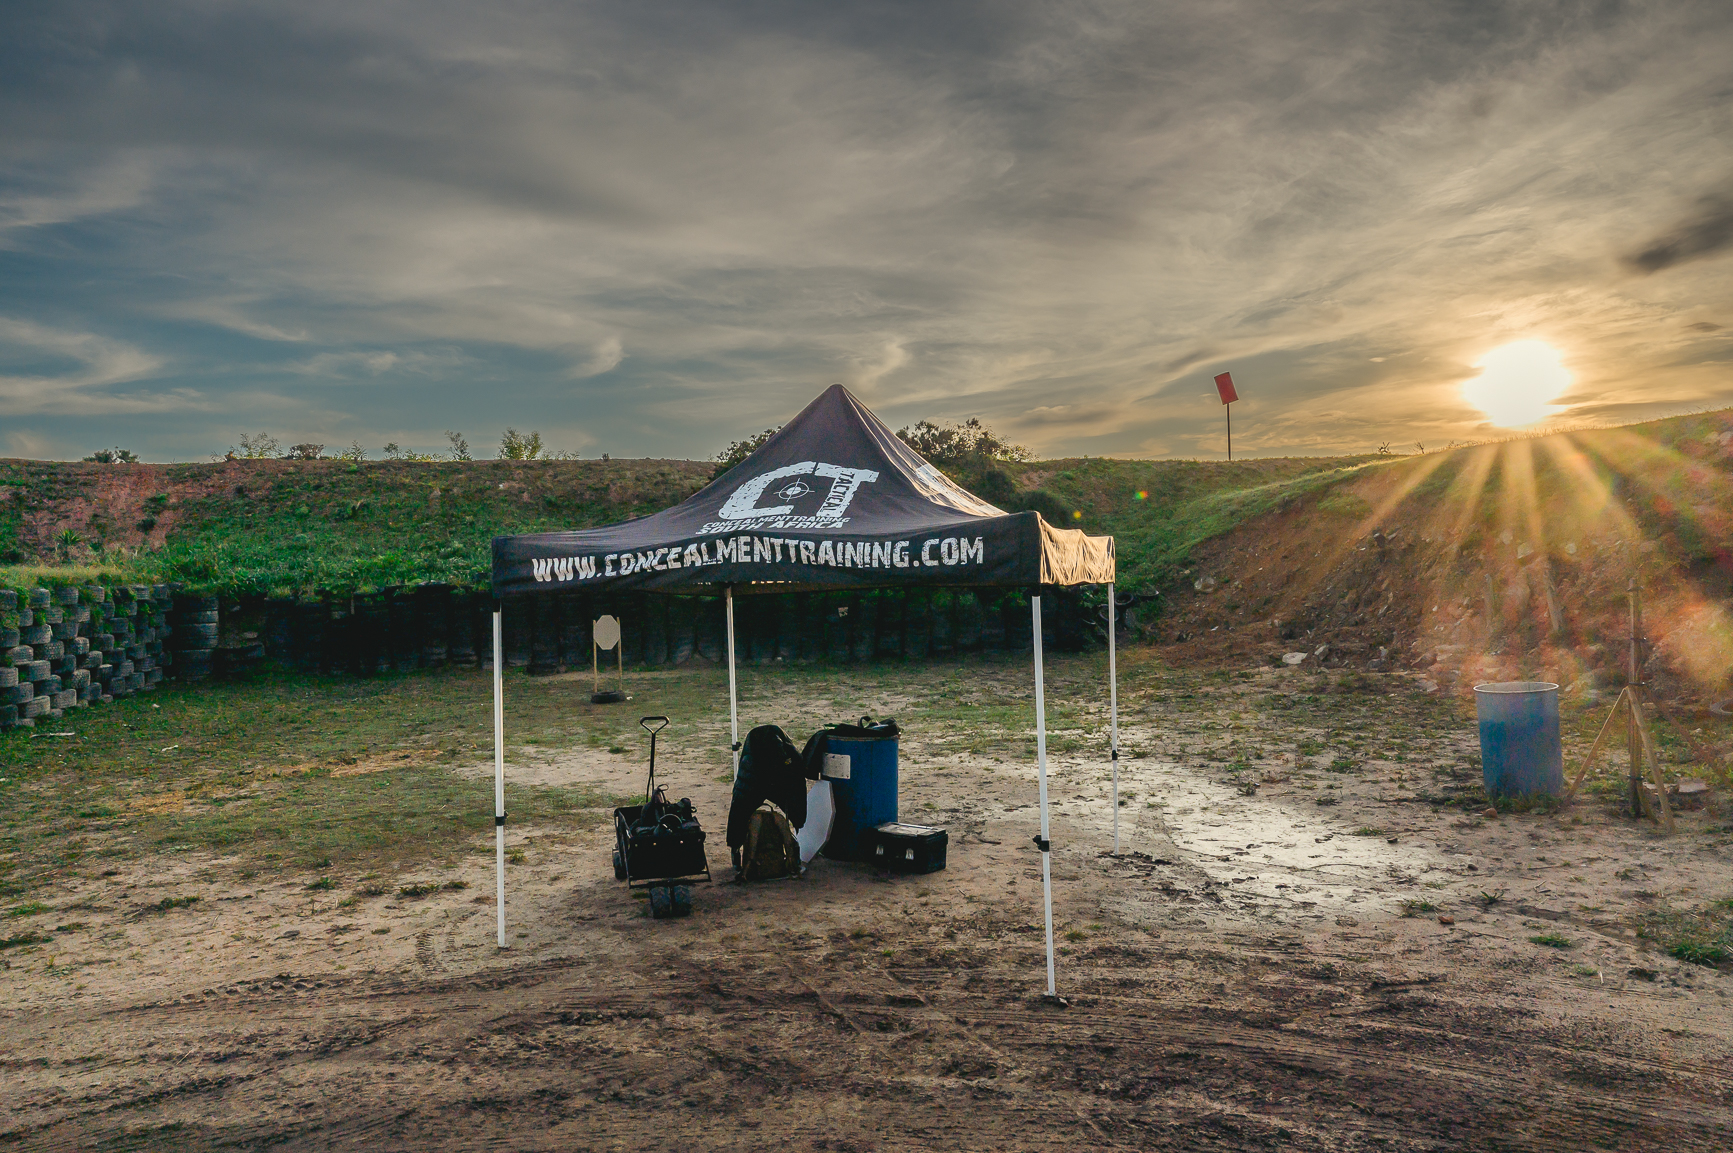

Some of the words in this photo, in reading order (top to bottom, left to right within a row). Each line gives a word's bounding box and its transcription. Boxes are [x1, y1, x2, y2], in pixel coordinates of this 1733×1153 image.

[820, 473, 855, 512] TACTICAL
[695, 521, 764, 535] SOUTH
[767, 521, 845, 529] AFRICA
[532, 535, 984, 582] WWW.CONCEALMENTTRAINING.COM
